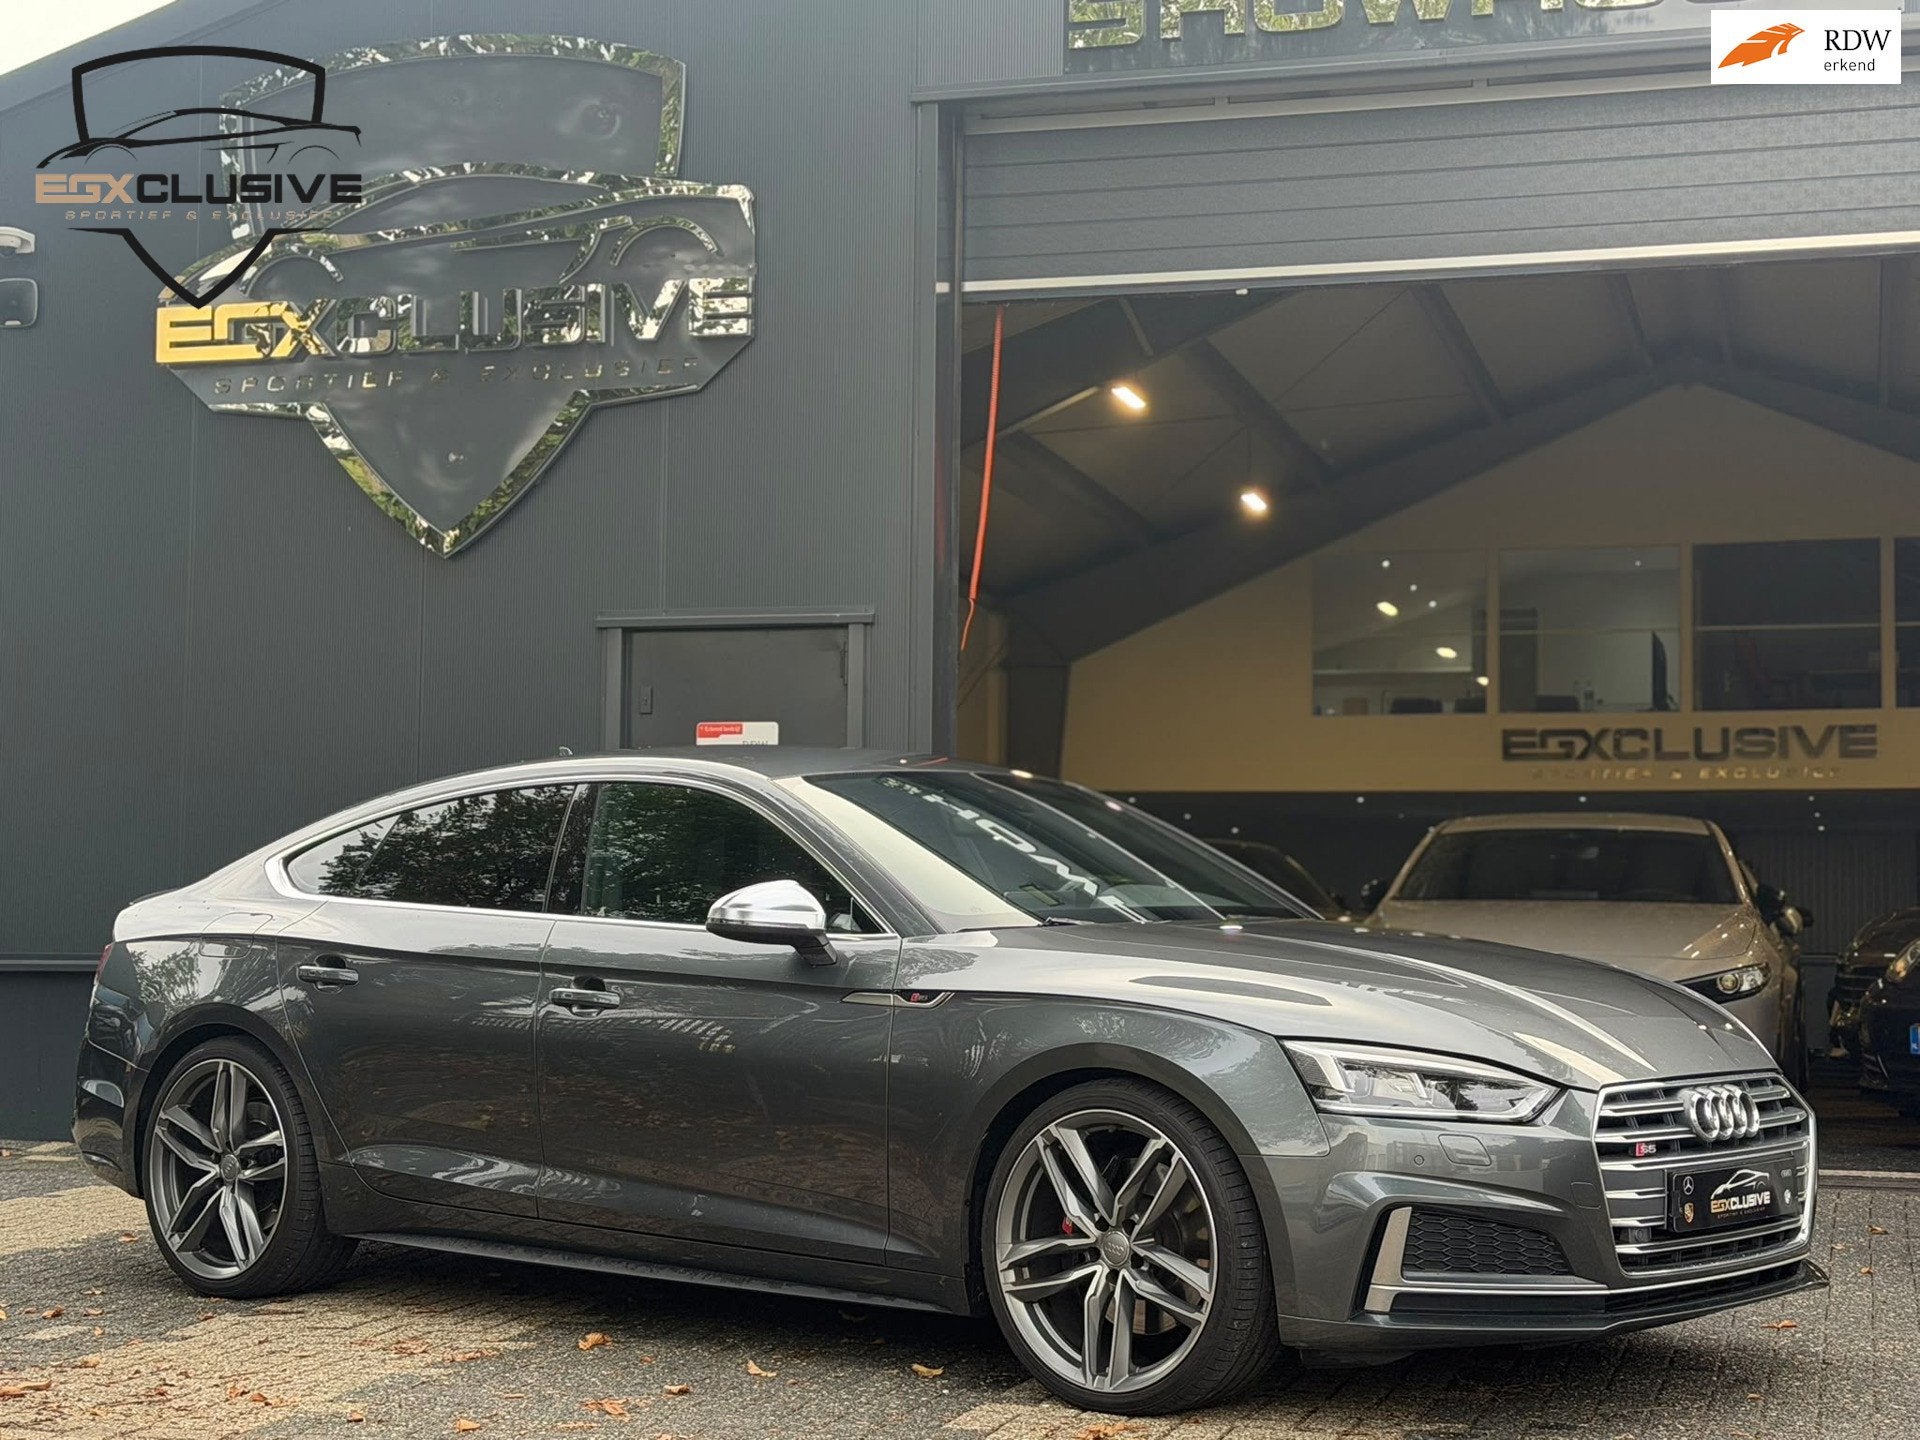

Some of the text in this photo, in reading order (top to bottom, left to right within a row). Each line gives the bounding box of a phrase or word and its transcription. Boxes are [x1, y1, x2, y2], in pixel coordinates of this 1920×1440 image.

[156, 276, 753, 363] EGXCLUSIVE
[214, 370, 403, 394] SPORTIEF
[1502, 723, 1878, 762] EGXCLUSIVE
[1710, 1191, 1771, 1213] EGXCLUSIVE
